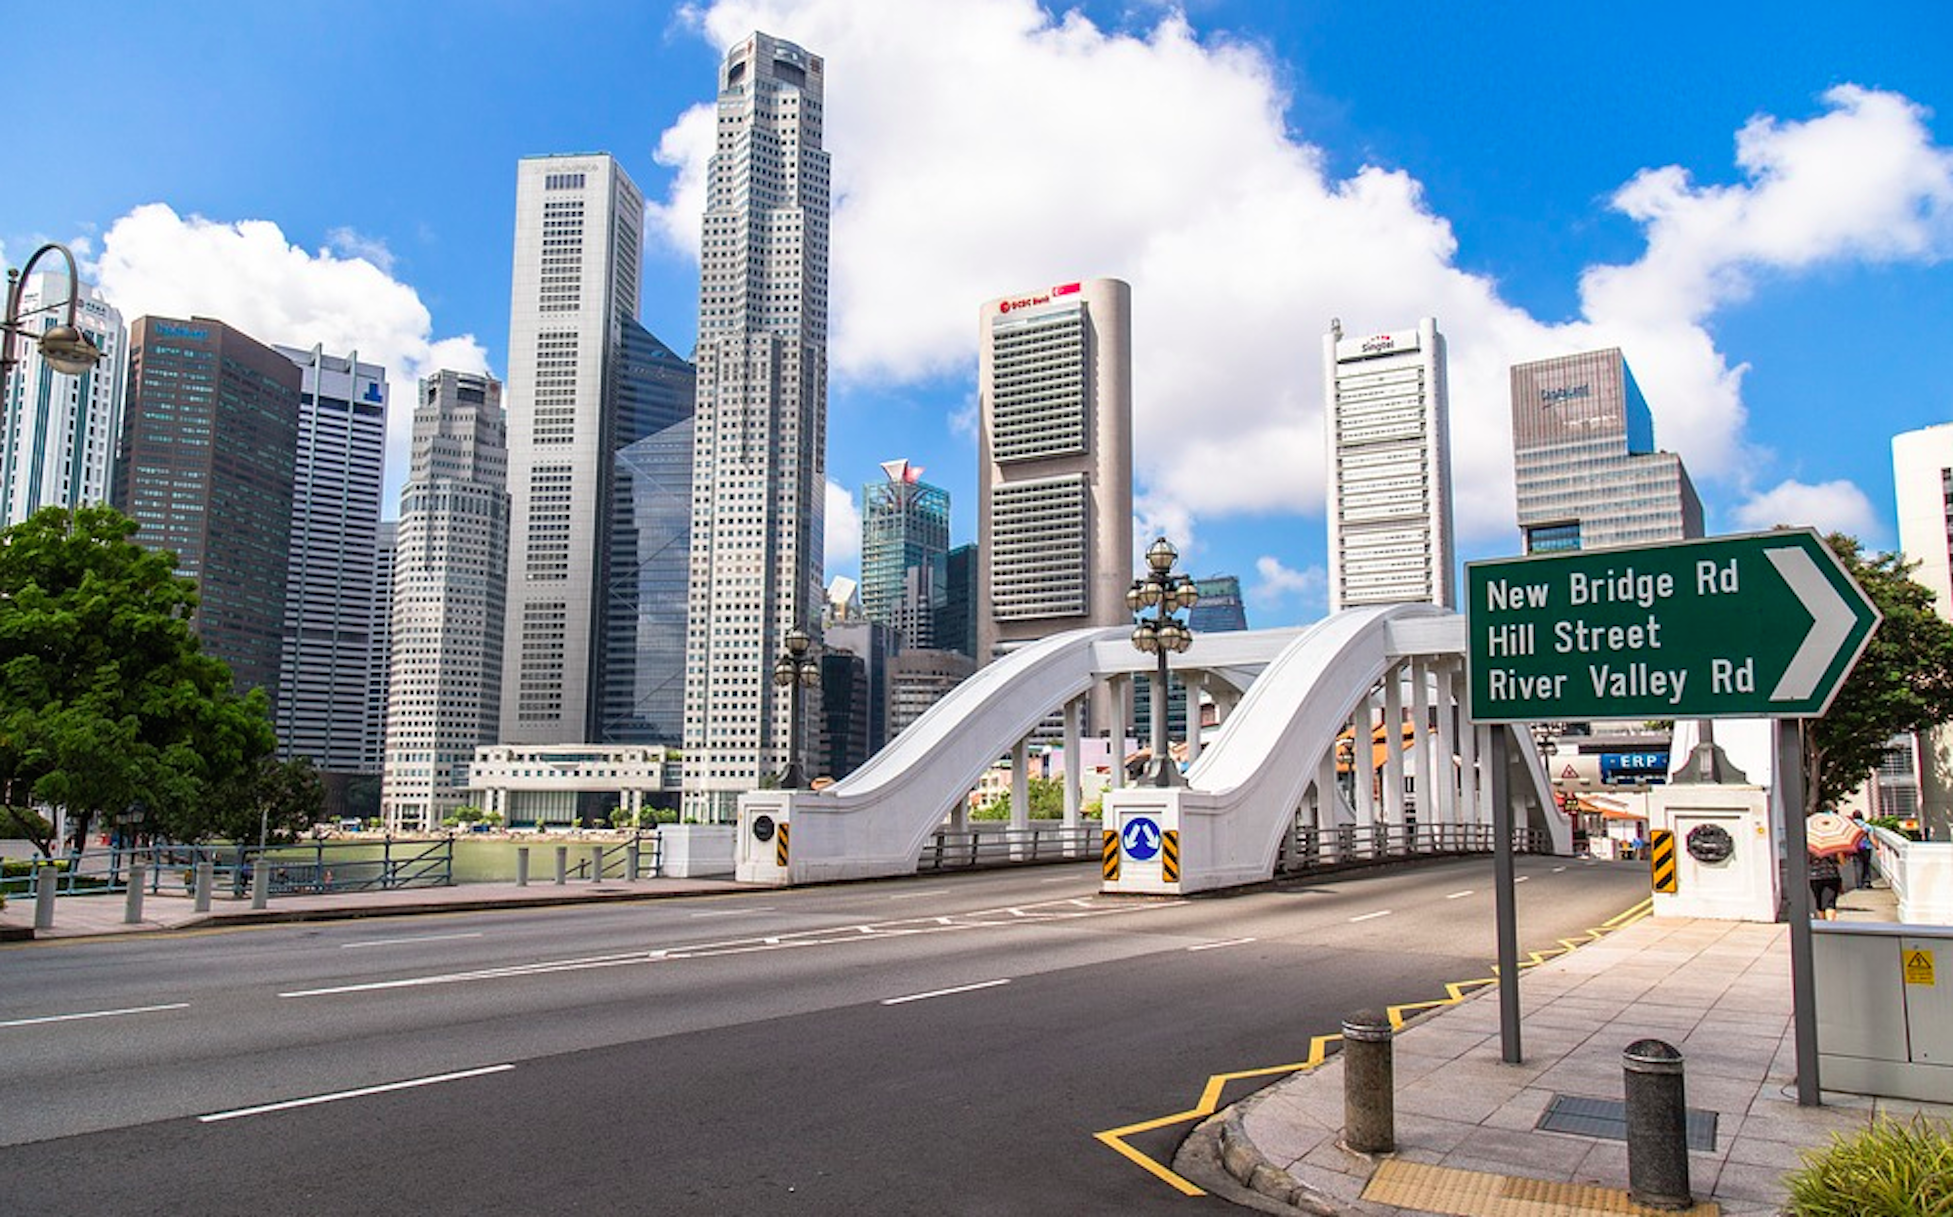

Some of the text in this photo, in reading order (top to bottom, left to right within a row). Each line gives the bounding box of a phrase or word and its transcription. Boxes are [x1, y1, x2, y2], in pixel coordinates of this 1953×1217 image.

[1362, 340, 1394, 352] Singtel
[1487, 558, 1739, 612] New Bridge Rd
[1488, 614, 1662, 657] Hill Street
[1489, 657, 1755, 704] River Valley Rd
[1619, 754, 1658, 769] ERP
